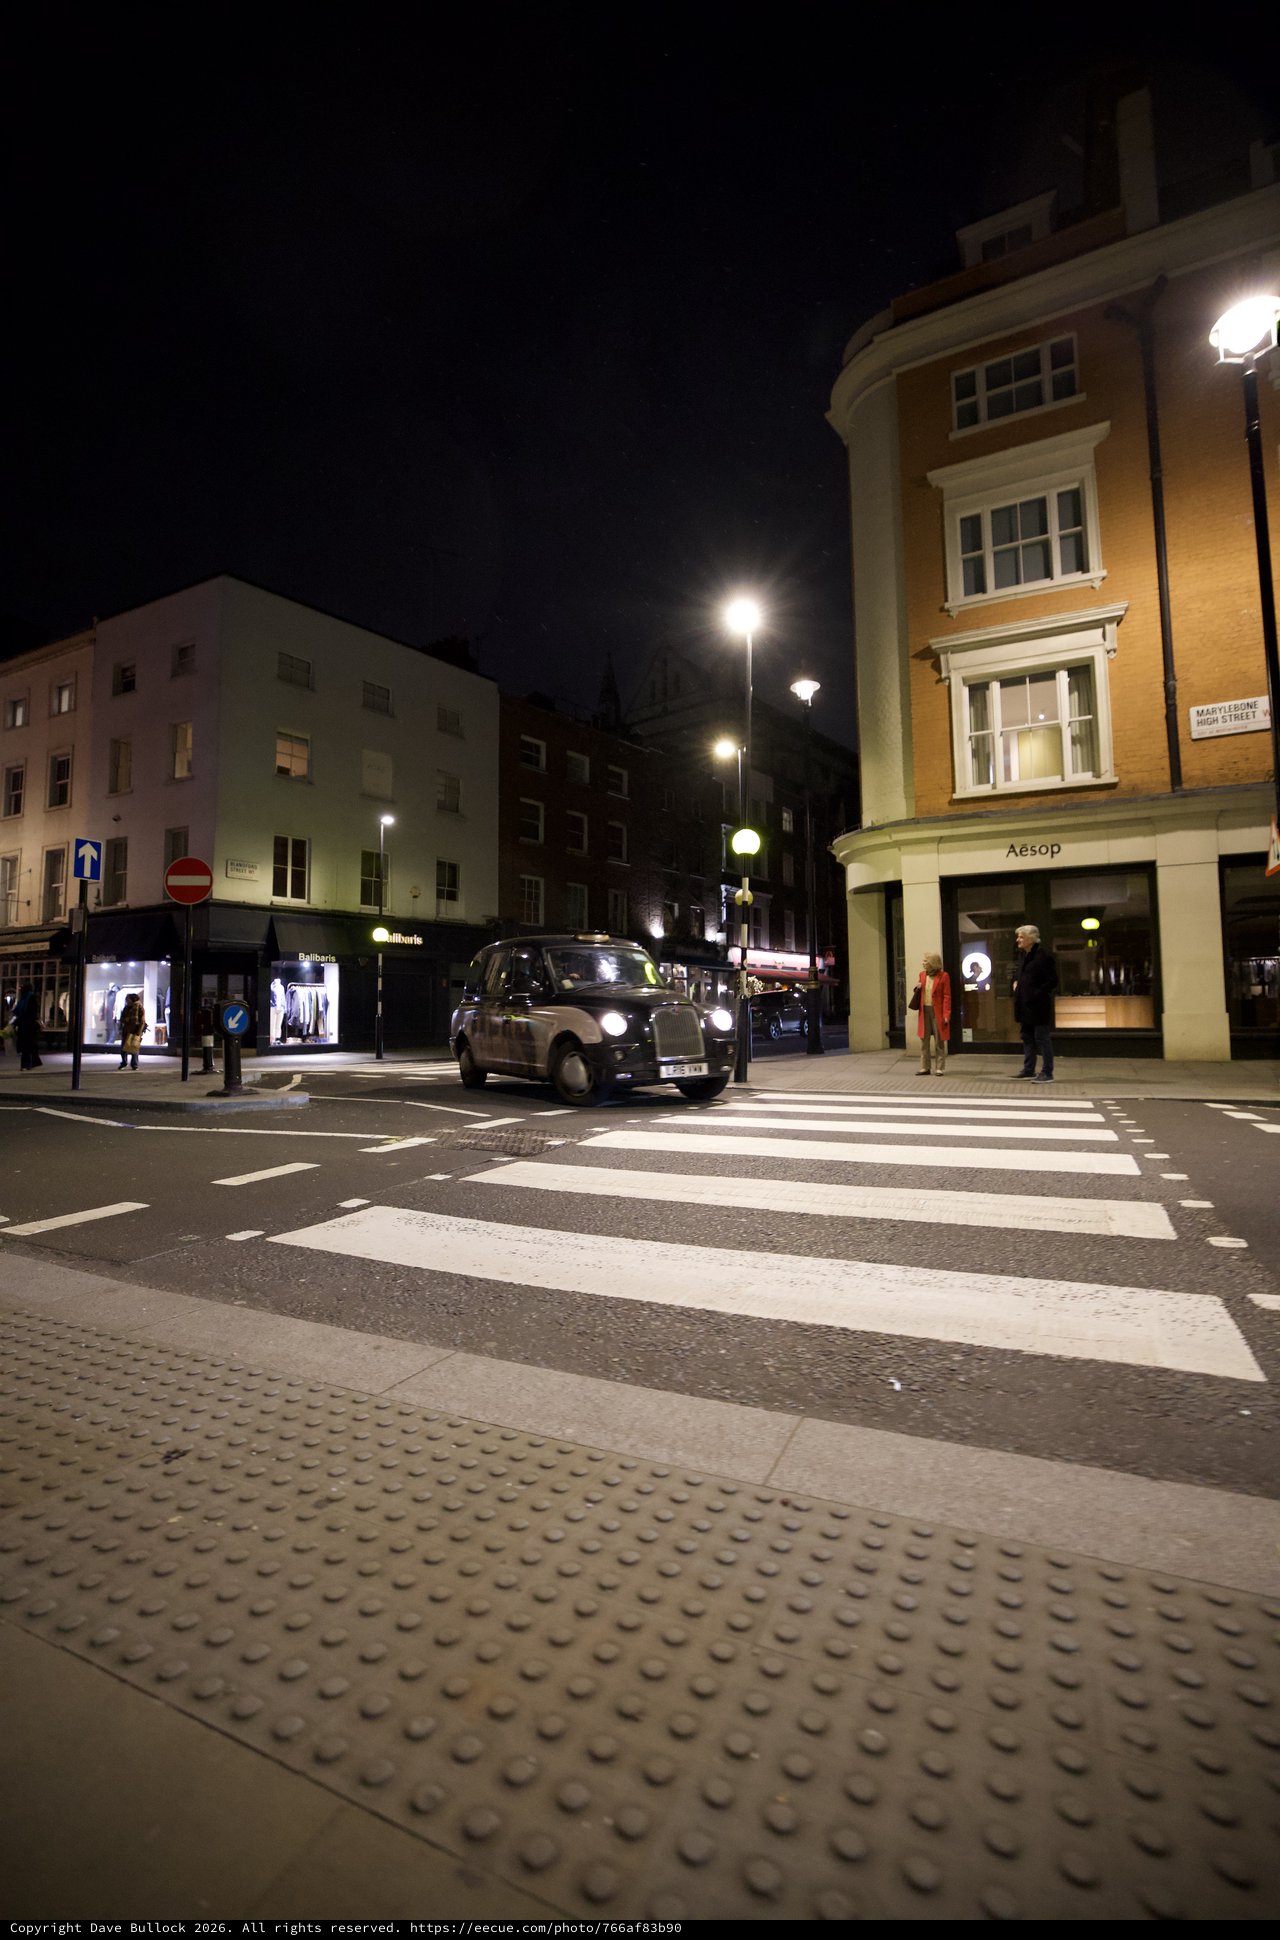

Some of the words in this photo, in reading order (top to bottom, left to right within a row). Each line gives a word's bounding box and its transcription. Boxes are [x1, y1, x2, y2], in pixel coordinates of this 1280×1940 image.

[1196, 700, 1259, 718] MARYLEBONE
[1196, 716, 1219, 727] HIGH
[1221, 710, 1257, 724] STREET
[1005, 843, 1062, 860] Aēsop
[387, 932, 424, 945] alibaris
[298, 952, 336, 963] Balibaris
